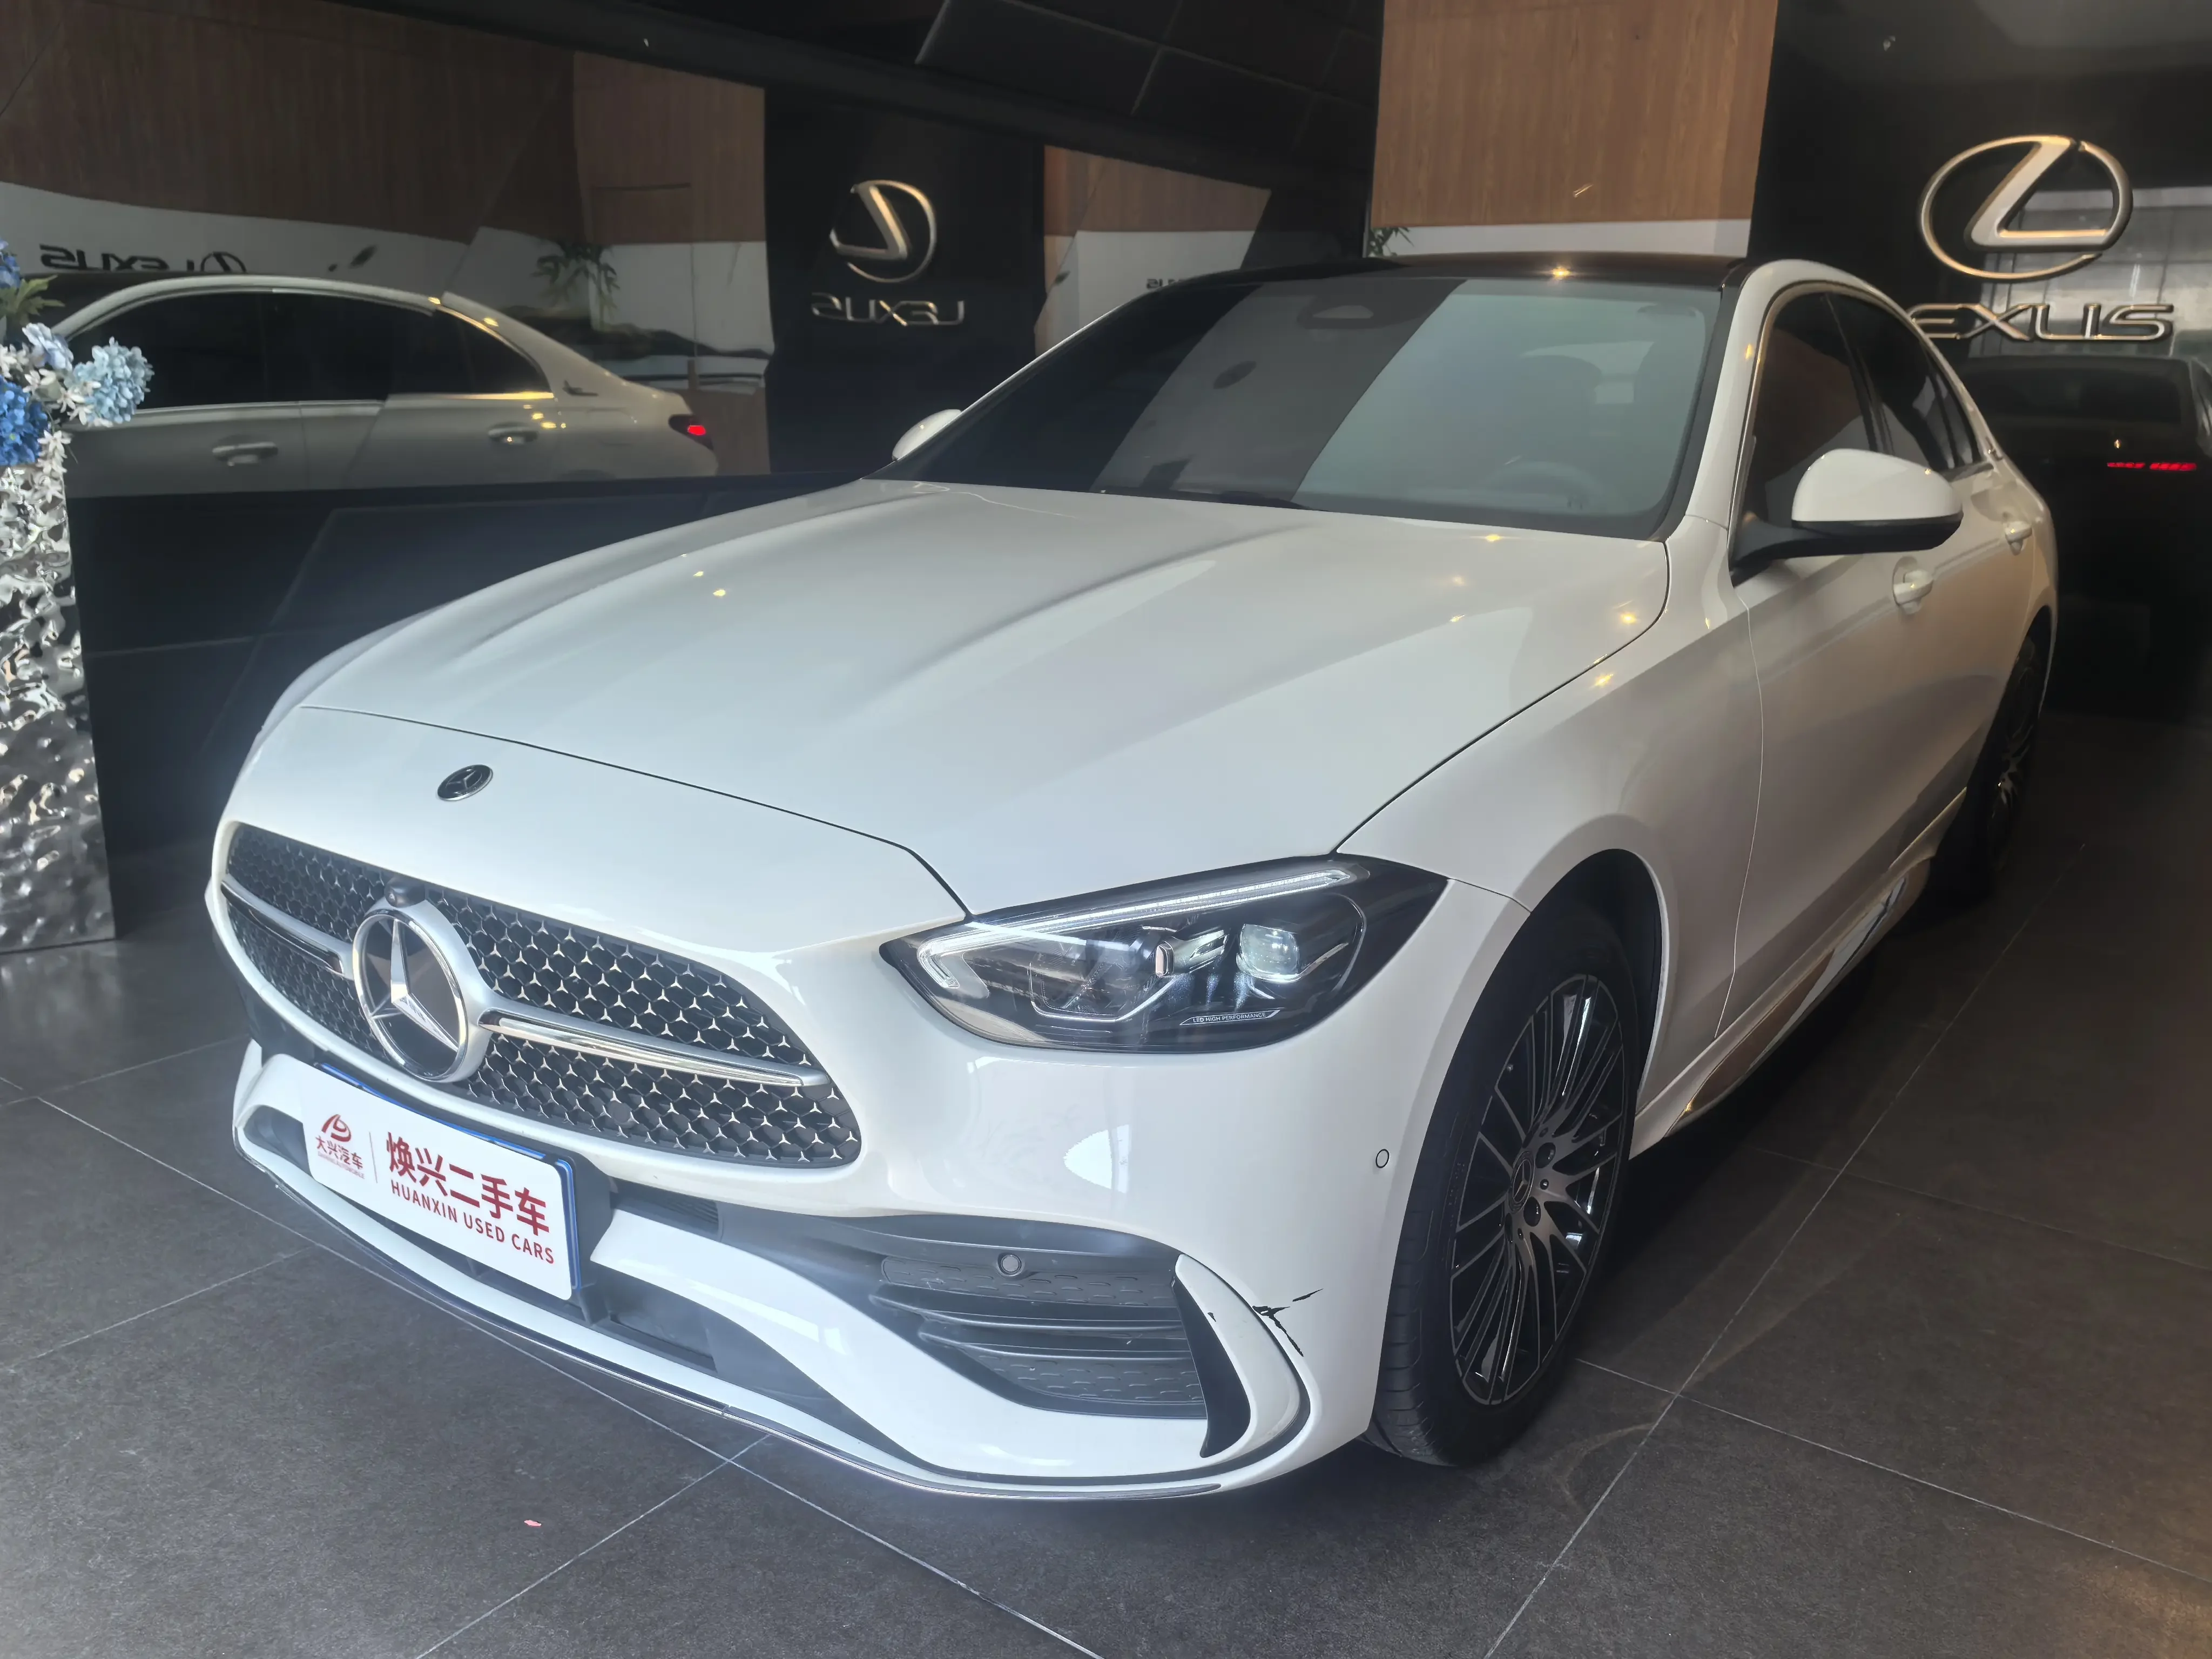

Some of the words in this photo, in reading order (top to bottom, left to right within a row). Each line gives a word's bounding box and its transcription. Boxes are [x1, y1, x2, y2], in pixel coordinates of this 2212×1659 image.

[1906, 302, 2174, 342] EXUS
[1222, 1013, 1266, 1021] PERFORMANCE
[315, 1135, 363, 1170] 大兴汽车
[386, 1131, 549, 1236] 焕兴二手车
[391, 1179, 457, 1223] HUANXIN
[463, 1212, 505, 1243] USED
[512, 1233, 554, 1264] CARS
